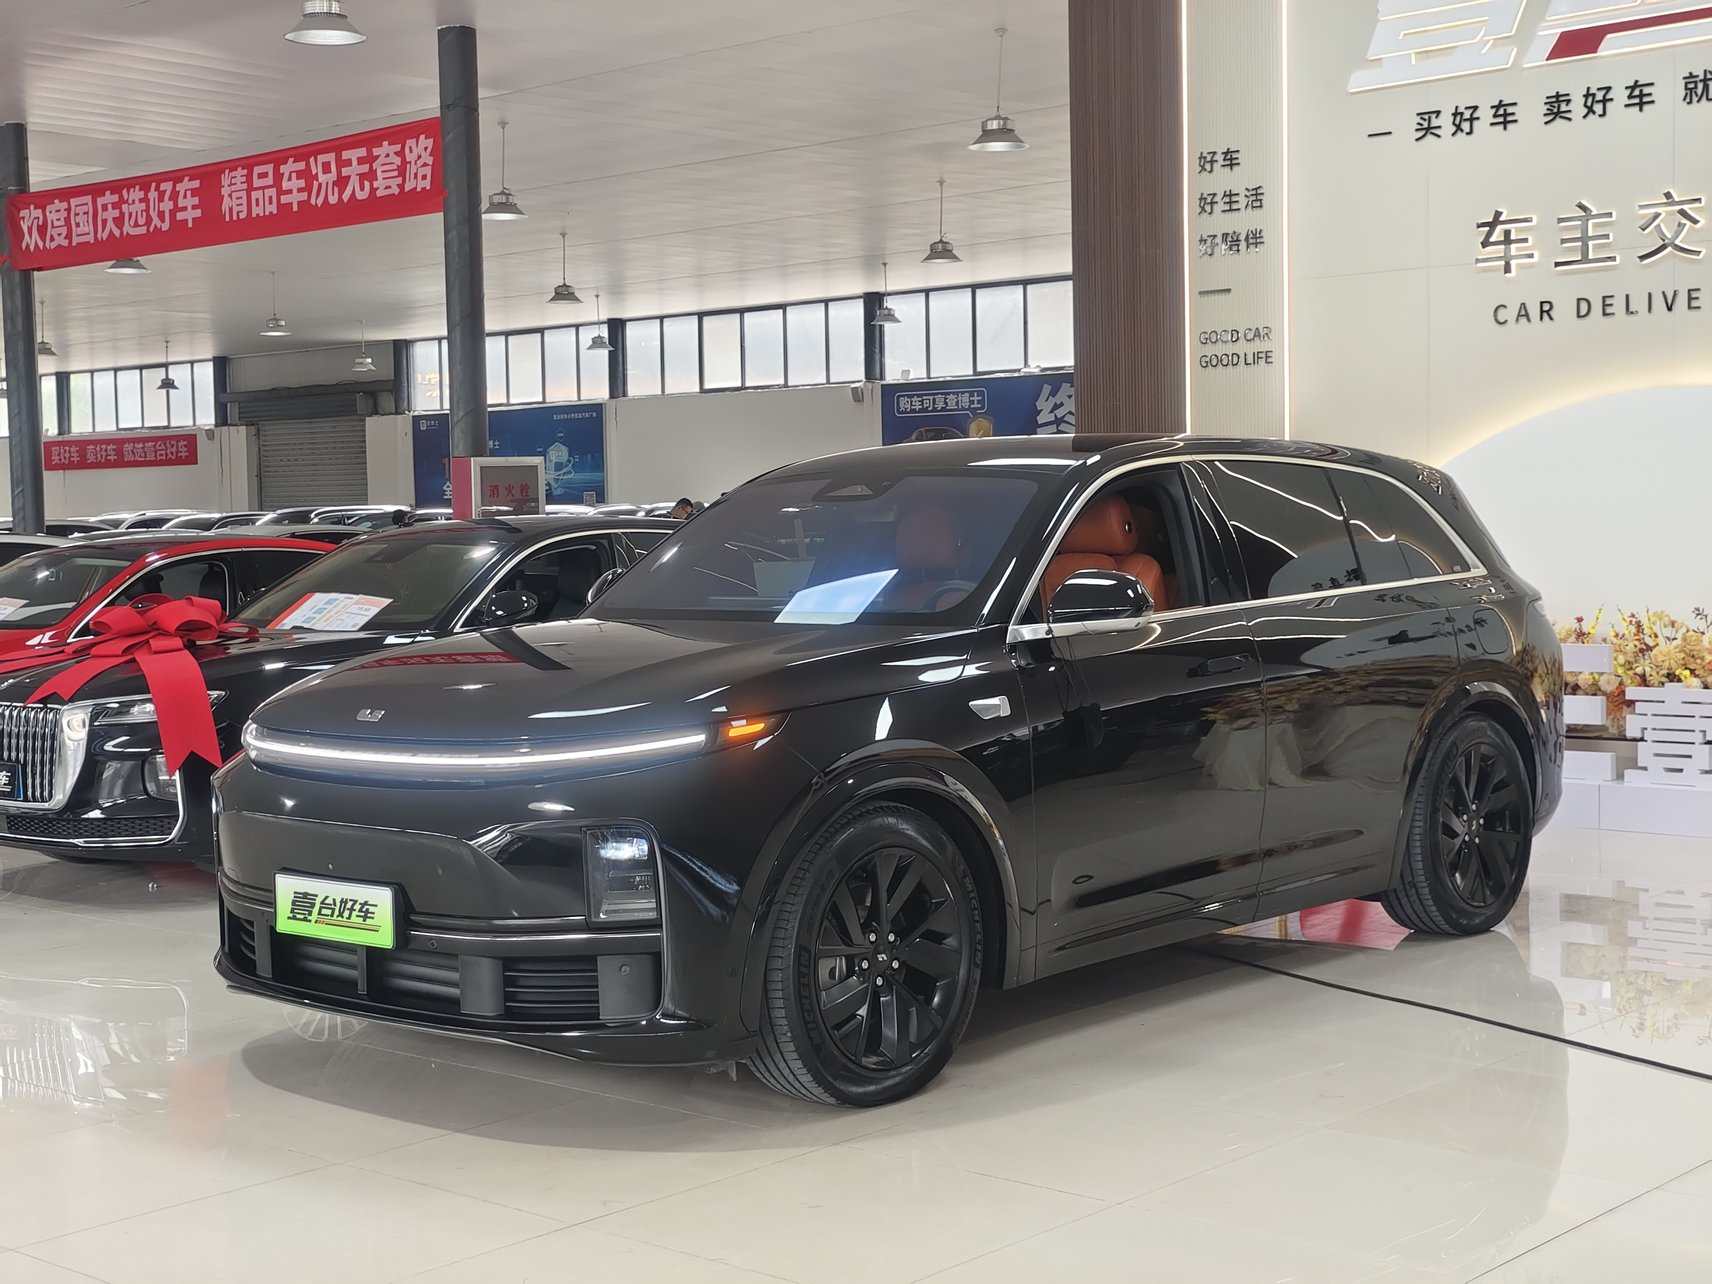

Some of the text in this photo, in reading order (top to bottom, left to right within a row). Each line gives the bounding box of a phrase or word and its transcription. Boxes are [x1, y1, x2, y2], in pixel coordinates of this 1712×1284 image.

[1413, 99, 1519, 142] 买好车
[1542, 79, 1656, 124] 卖好车
[1198, 147, 1241, 175] 好车
[19, 134, 435, 252] 欢度国庆选好车 精品车况无套路
[1198, 185, 1265, 216] 好生活
[1198, 228, 1265, 258] 好陪伴
[1475, 190, 1704, 277] 车主交
[1493, 288, 1703, 326] CAR DELIVE
[1199, 326, 1273, 345] GOOD CAR
[1199, 350, 1274, 368] GOOD LIFE
[899, 392, 983, 412] 购车可享查博士
[51, 440, 189, 465] 买好车 卖好车 就选壹台好车
[488, 483, 530, 498] 消火栓
[287, 890, 378, 924] 壹台好车
